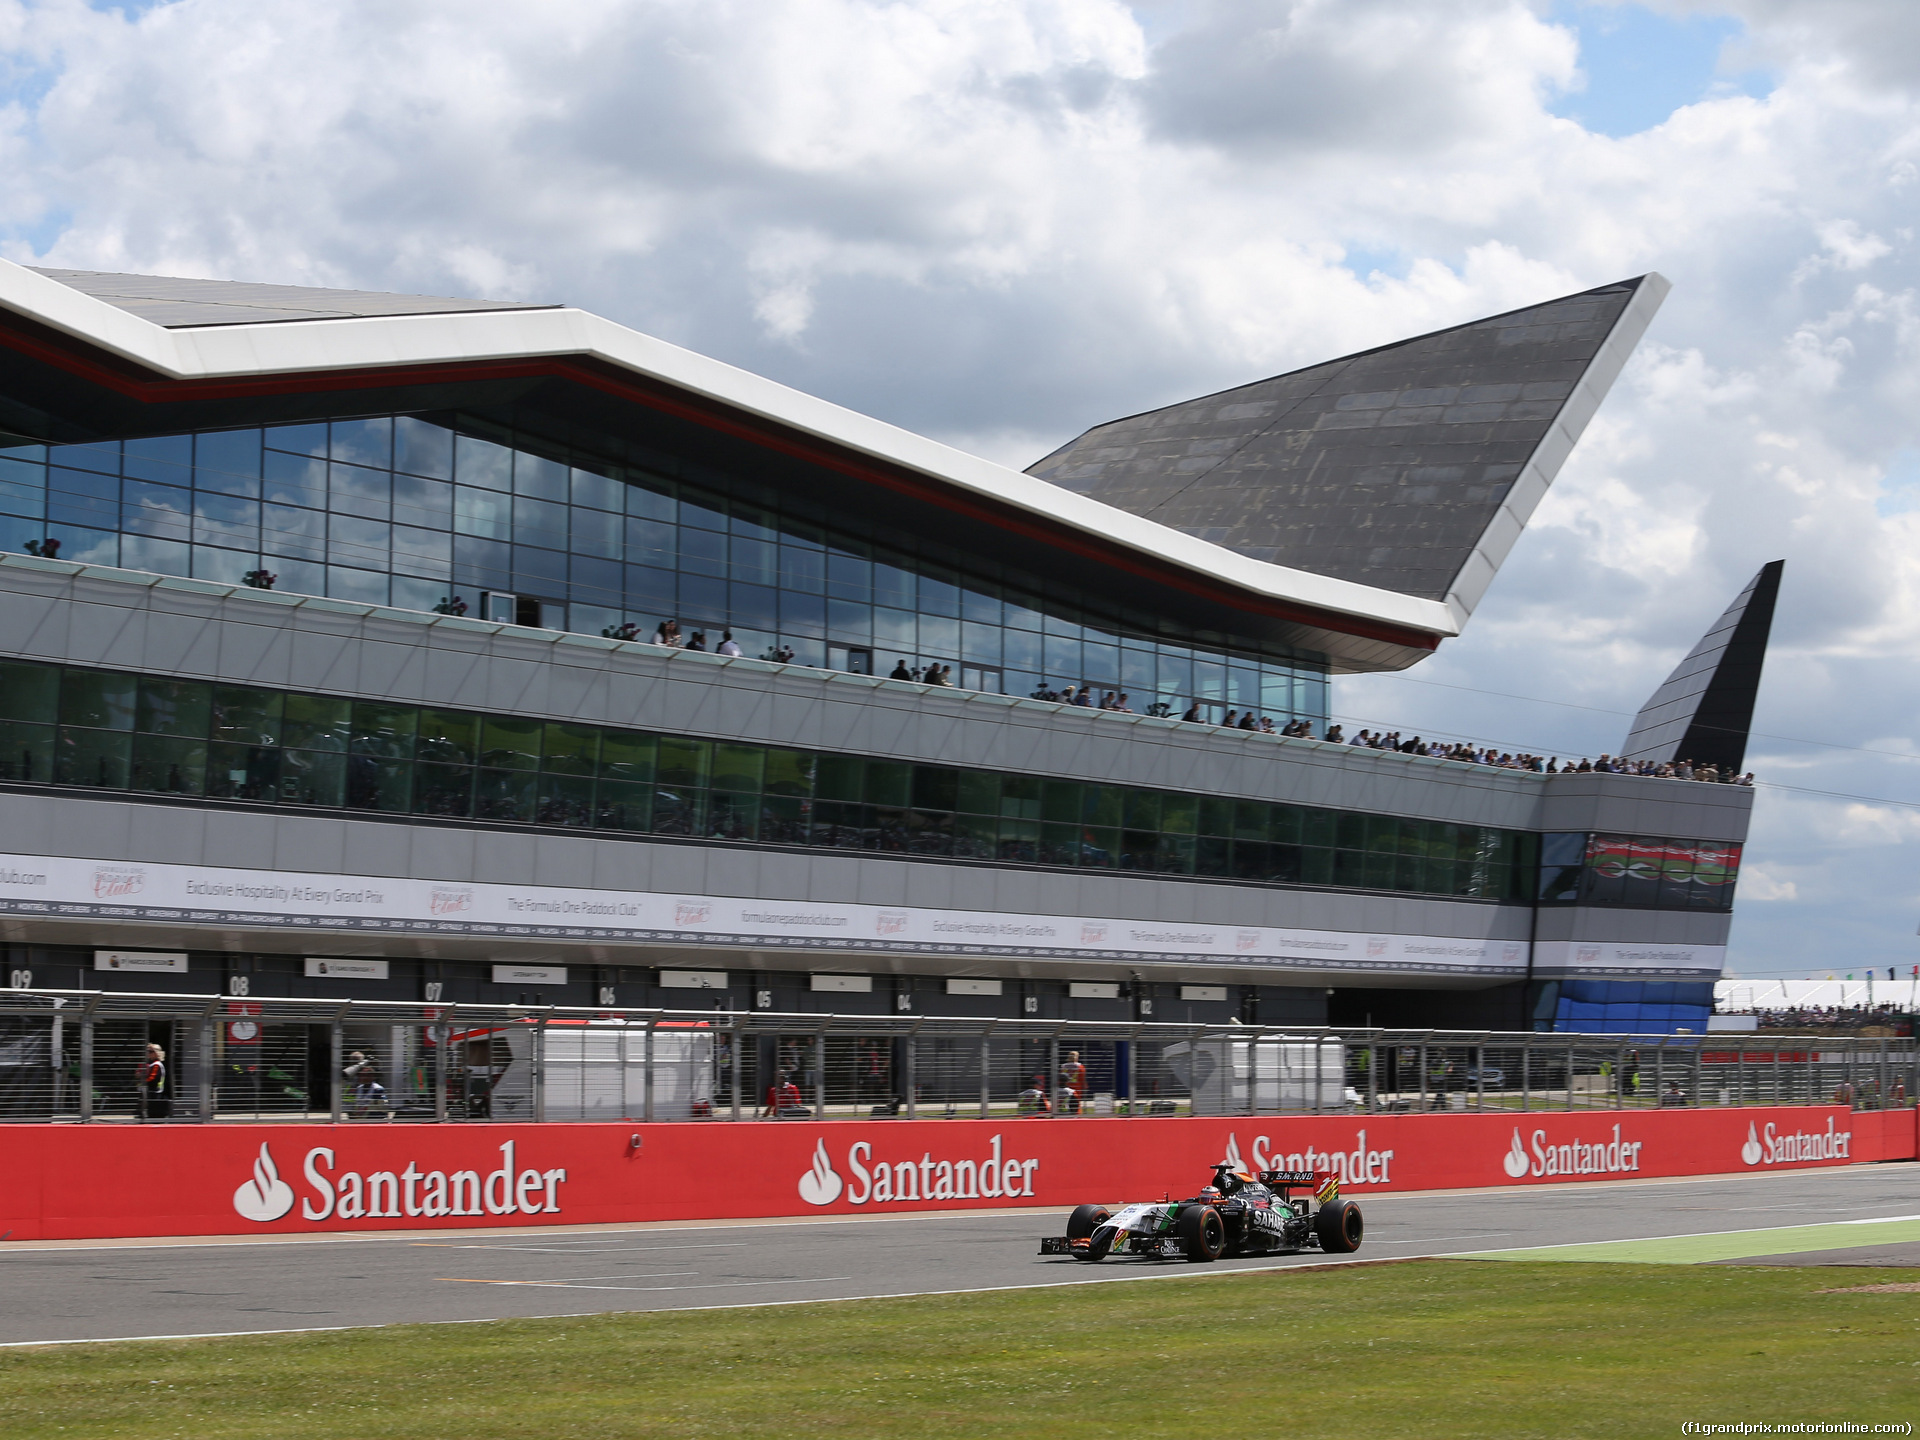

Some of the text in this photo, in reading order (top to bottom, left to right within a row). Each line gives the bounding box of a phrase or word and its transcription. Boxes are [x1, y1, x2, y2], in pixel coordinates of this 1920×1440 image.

[0, 868, 47, 885] lub.com
[186, 880, 384, 905] Exclusive Hospitality At Every Grand Prix
[507, 897, 524, 911] The
[525, 898, 561, 913] Formula
[562, 900, 581, 914] One
[582, 901, 617, 915] Paddock
[11, 970, 33, 990] 09
[229, 976, 249, 996] 08
[425, 982, 443, 1001] 07
[600, 987, 616, 1005] 06
[757, 990, 771, 1008] 05
[897, 994, 911, 1011] 04
[1024, 997, 1038, 1013] 03
[1763, 1115, 1851, 1164] Santander
[1531, 1123, 1642, 1178] Santander
[848, 1134, 1039, 1205] Santander
[302, 1140, 566, 1221] Santander
